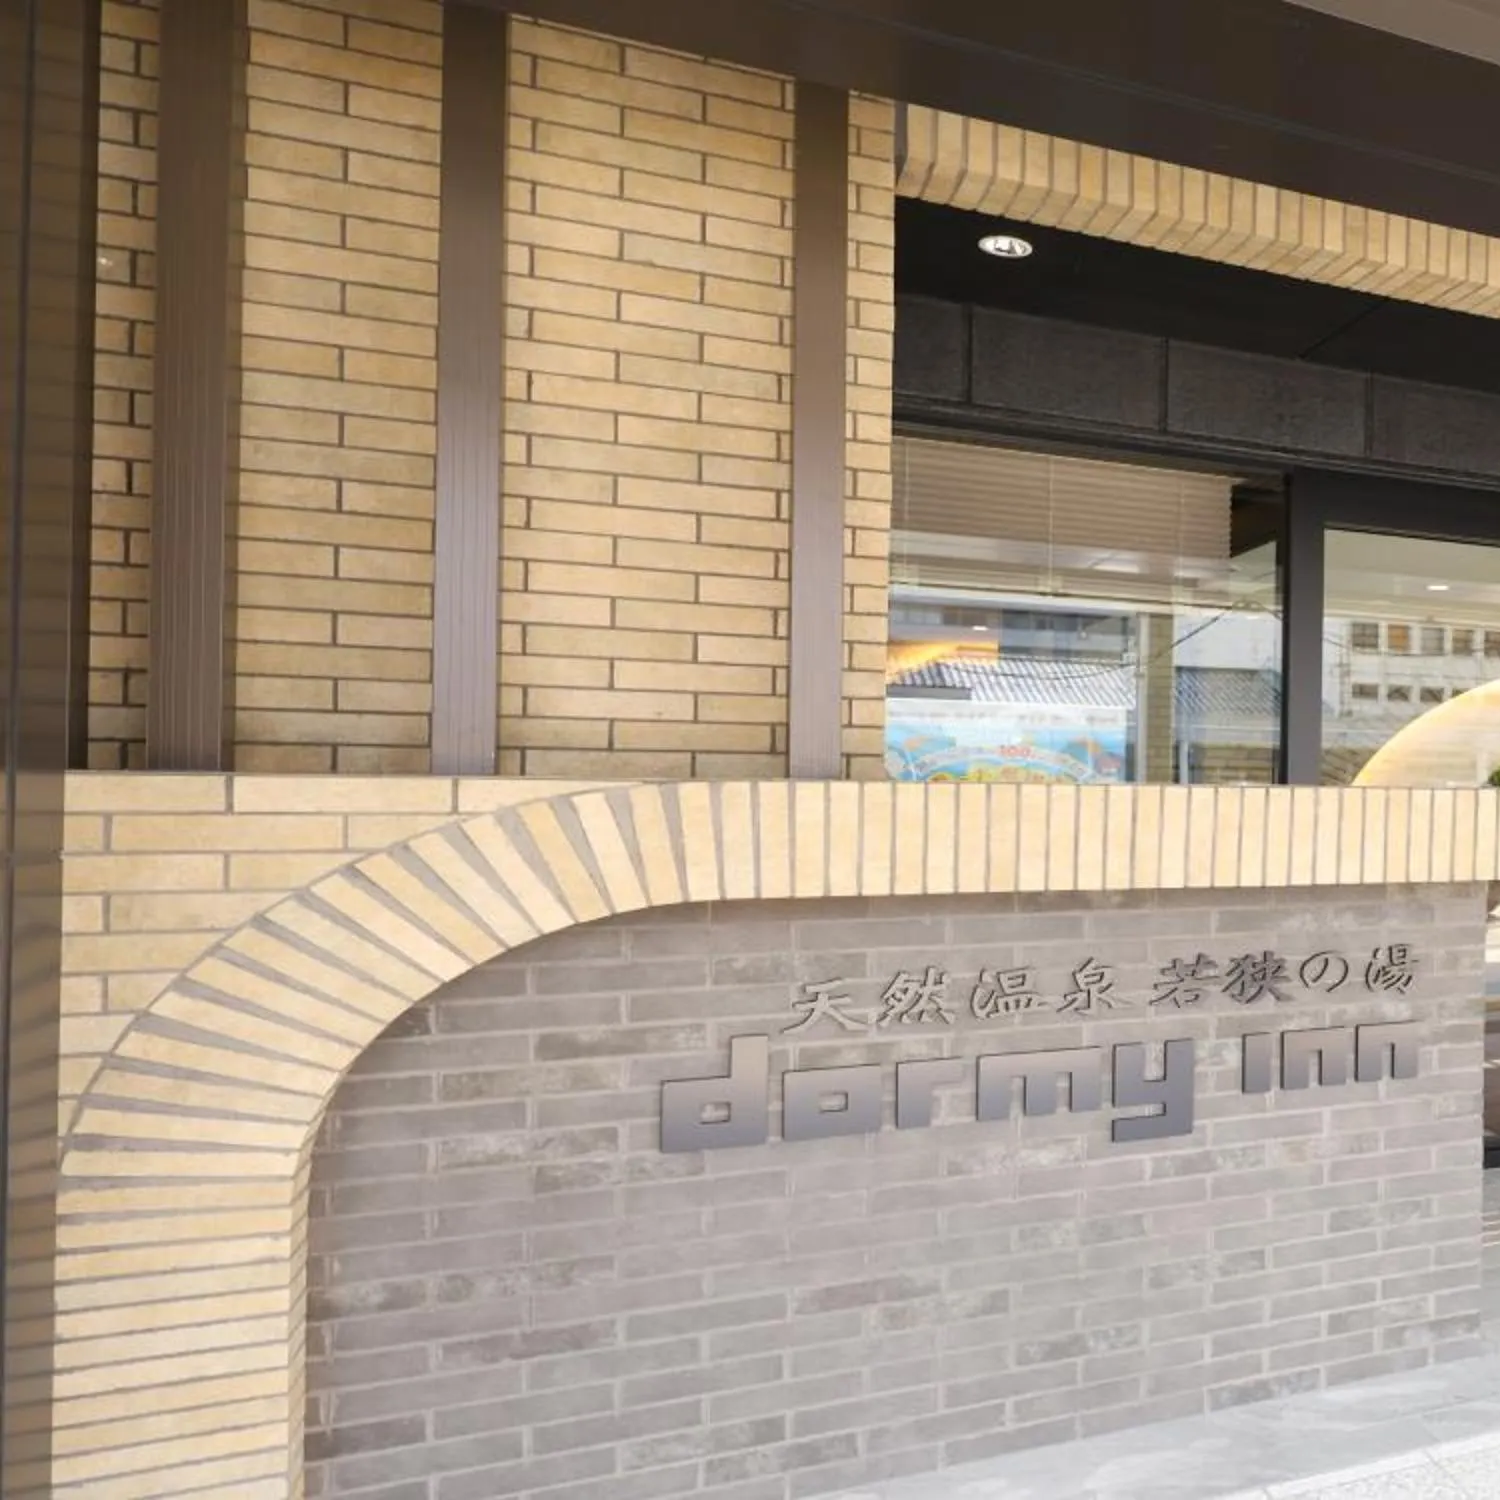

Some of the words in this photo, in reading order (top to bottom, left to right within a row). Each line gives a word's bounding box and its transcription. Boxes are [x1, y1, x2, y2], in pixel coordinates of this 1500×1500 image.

[780, 957, 1118, 1033] 天然温泉
[660, 1034, 1193, 1153] dormy
[1241, 1019, 1420, 1094] inn
